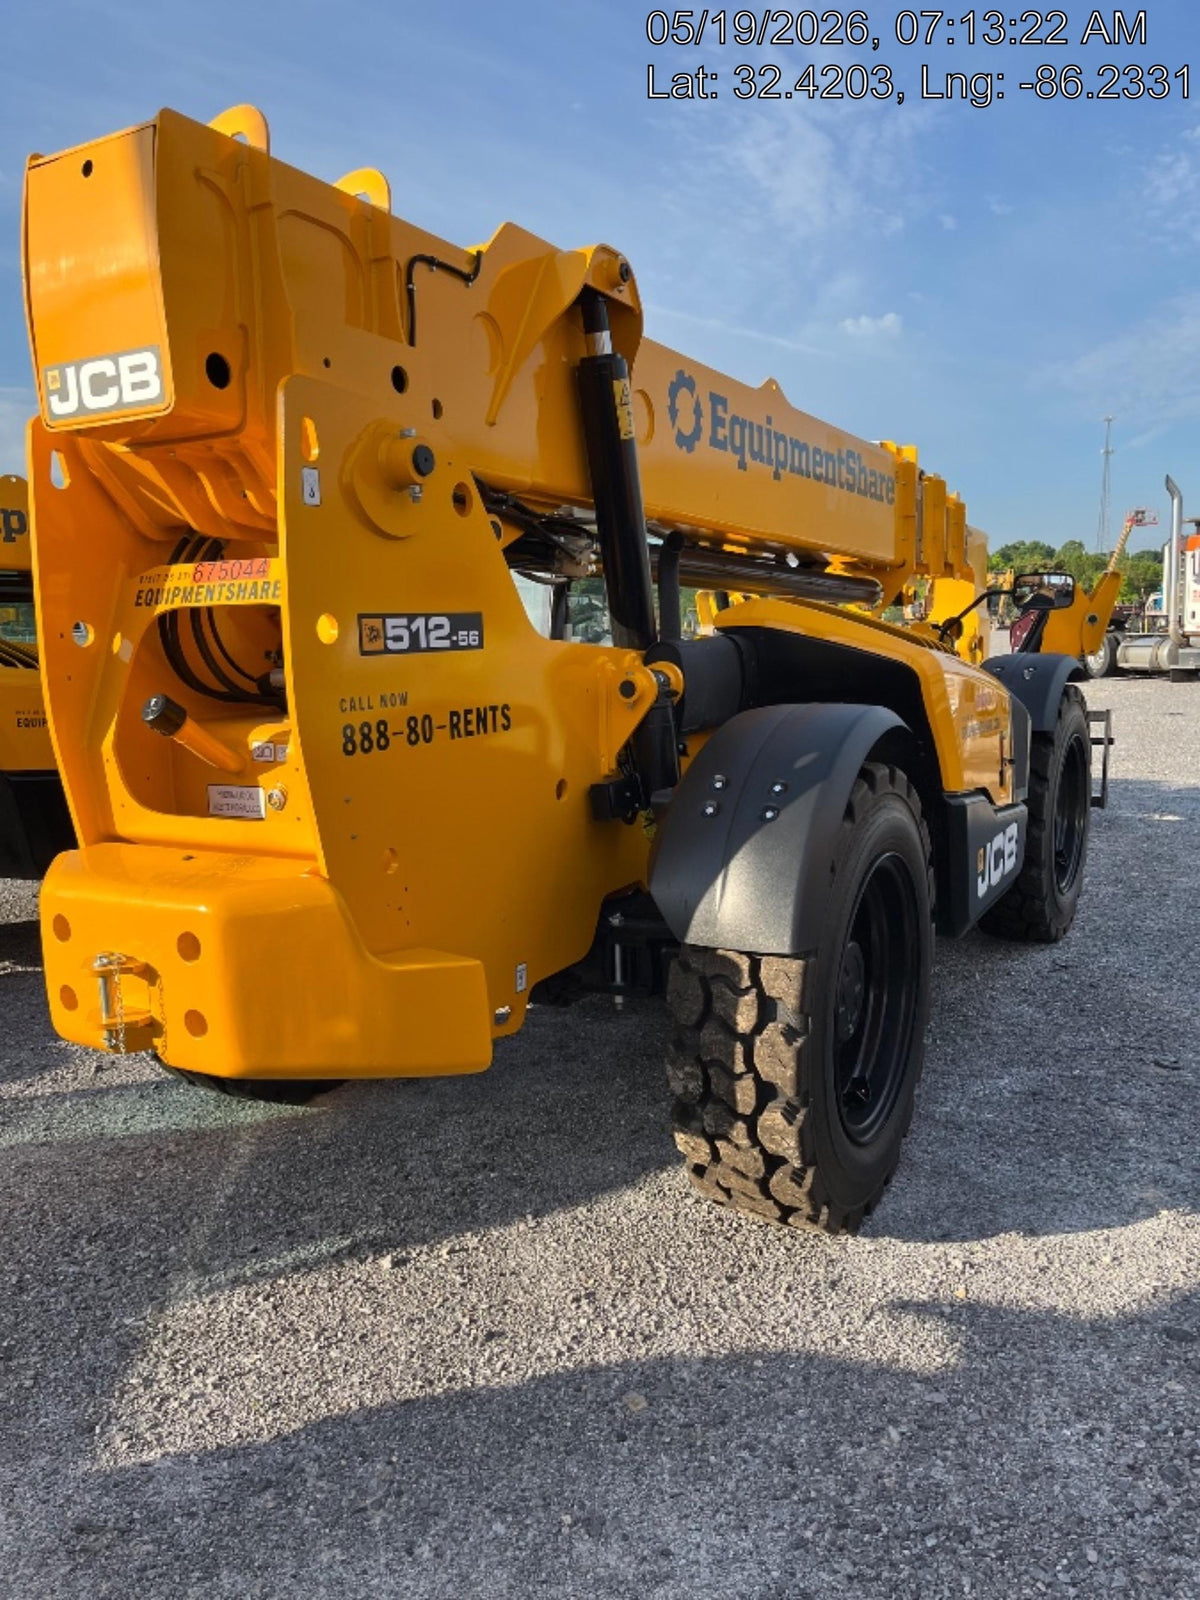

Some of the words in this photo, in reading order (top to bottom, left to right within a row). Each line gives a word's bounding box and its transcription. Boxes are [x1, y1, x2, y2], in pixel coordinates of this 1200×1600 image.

[48, 351, 161, 415] JCB
[708, 390, 896, 506] EquipmentShare
[0, 508, 27, 543] p
[192, 558, 269, 583] 675044
[134, 579, 282, 607] EQUIPMENTSHARE
[339, 697, 374, 713] CALL
[379, 691, 409, 708] NOW
[342, 703, 512, 756] 888-80-RENTS
[977, 822, 1018, 899] JCB
